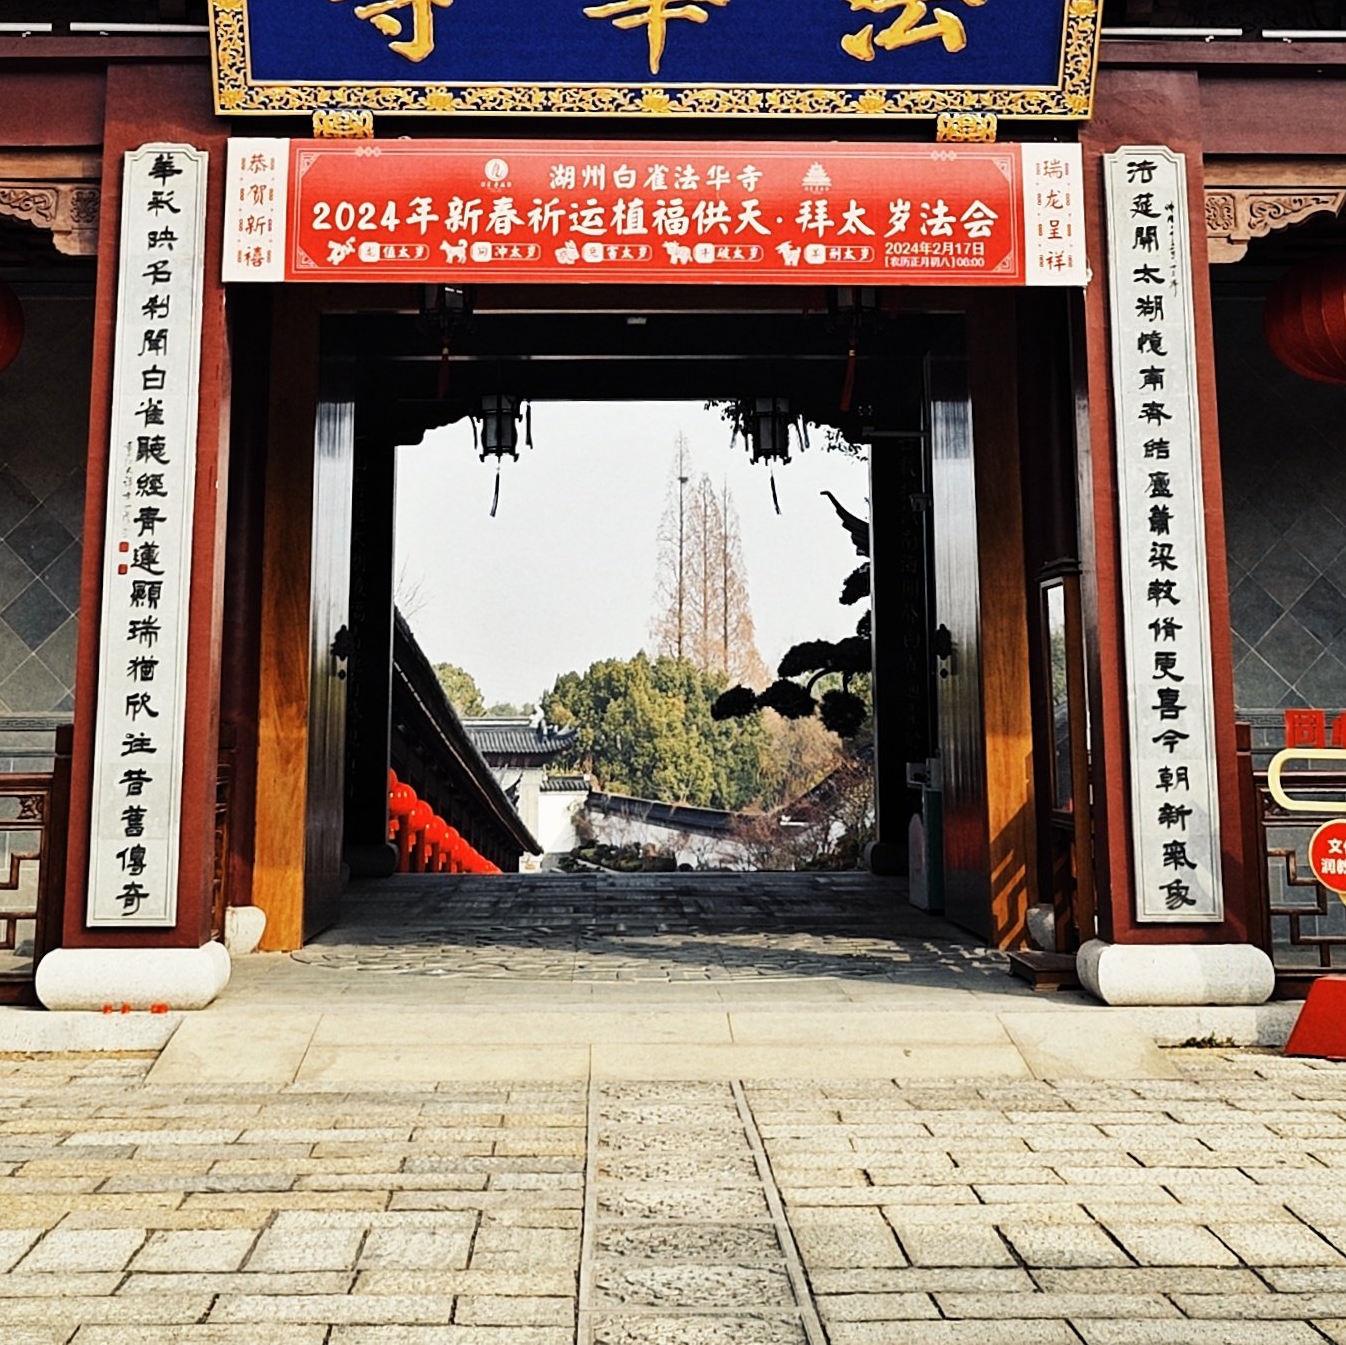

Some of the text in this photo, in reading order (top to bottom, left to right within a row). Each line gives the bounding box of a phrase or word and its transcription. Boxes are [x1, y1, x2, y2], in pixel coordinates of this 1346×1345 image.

[244, 153, 269, 268] 恭贺新禧
[548, 162, 764, 193] 湖州白雀法华寺
[884, 241, 985, 255] 2024年2月17日
[1042, 159, 1068, 272] 瑞龙呈祥
